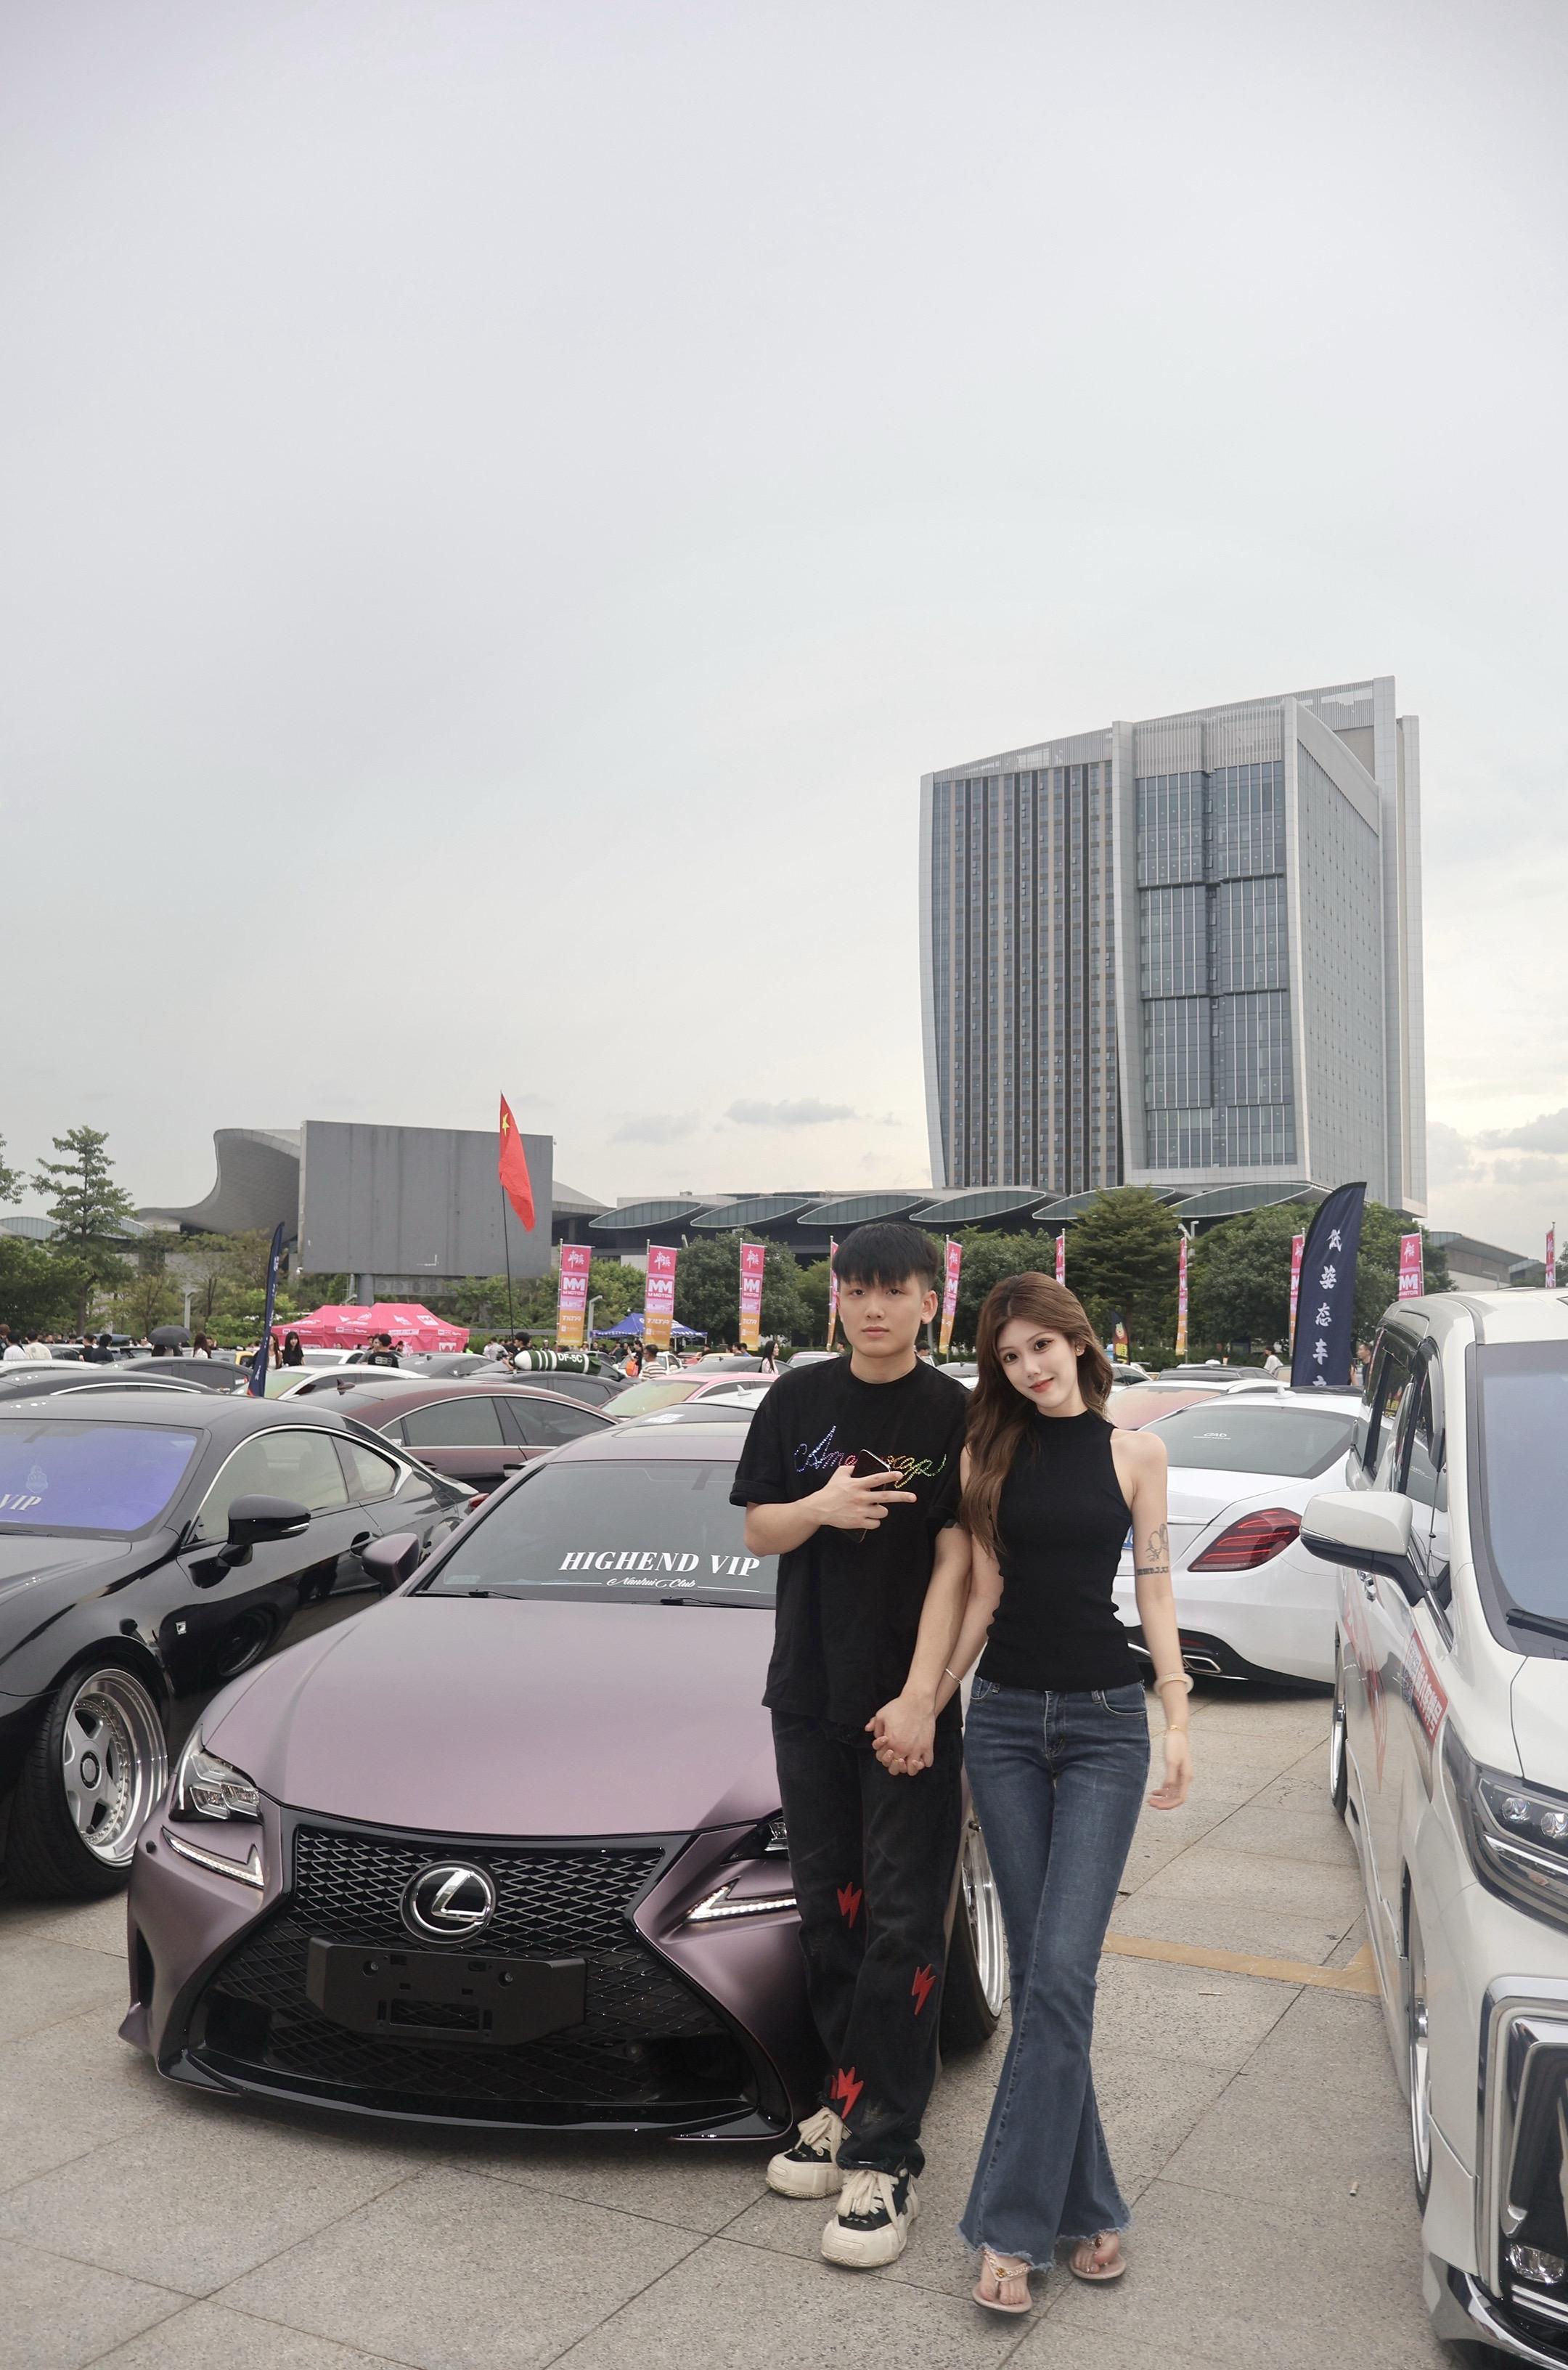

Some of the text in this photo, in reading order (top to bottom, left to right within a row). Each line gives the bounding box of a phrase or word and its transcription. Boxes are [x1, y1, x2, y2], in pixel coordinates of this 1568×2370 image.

[557, 1353, 584, 1363] DF-5C
[0, 1494, 42, 1511] VIP
[558, 1551, 761, 1576] HIGHEND VIP
[655, 1578, 696, 1588] Club
